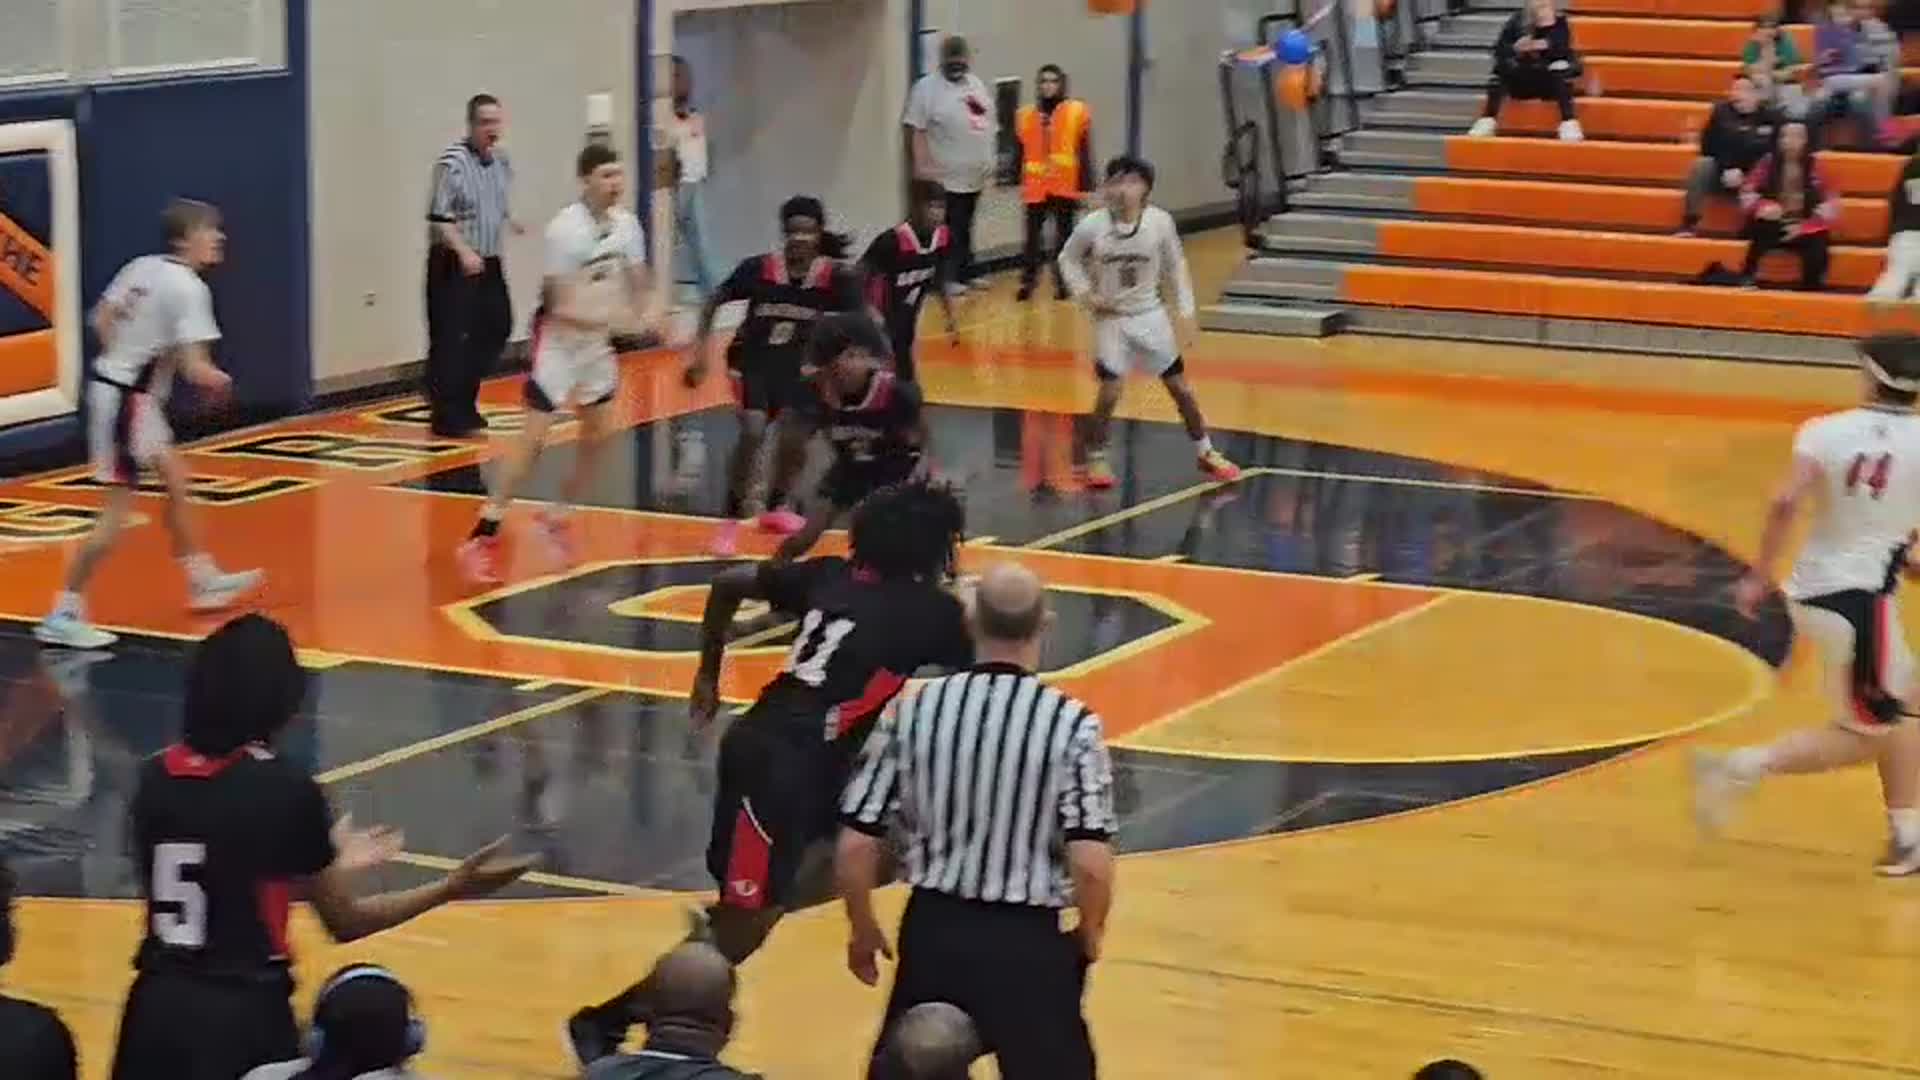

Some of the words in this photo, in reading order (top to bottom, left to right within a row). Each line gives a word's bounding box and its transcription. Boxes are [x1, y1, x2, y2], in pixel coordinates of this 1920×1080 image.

[1840, 451, 1892, 500] 14
[790, 605, 857, 689] 11
[153, 843, 208, 946] 5
